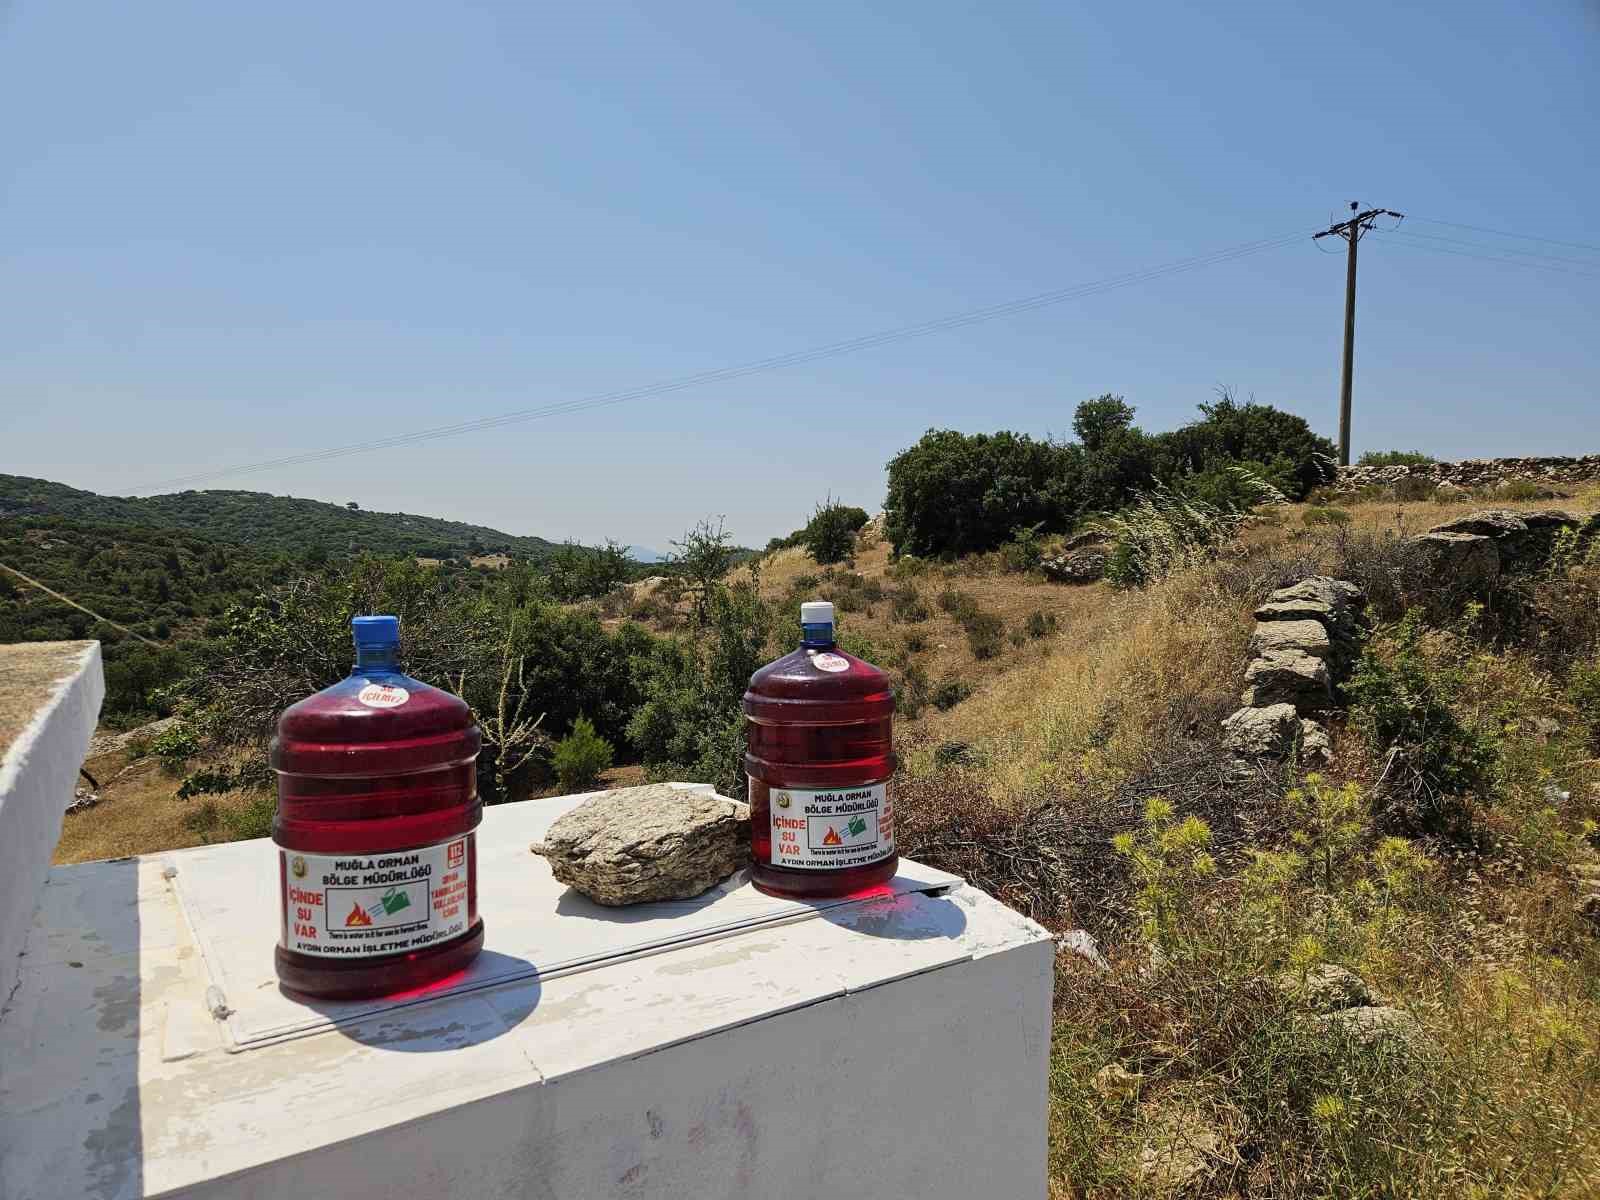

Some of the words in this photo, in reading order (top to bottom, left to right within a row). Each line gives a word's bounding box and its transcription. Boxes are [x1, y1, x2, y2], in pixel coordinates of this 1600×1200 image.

[814, 793, 843, 803] MUĞLA
[845, 791, 872, 801] ORMAN
[805, 804, 832, 814] BÖLGE
[835, 798, 879, 813] MÜDÜRLÜĞÜ
[772, 813, 806, 830] İÇİNDE
[782, 832, 796, 842] SU
[450, 843, 463, 859] 112
[778, 843, 800, 855] VAR
[335, 858, 376, 871] MUĞLA
[378, 854, 419, 868] ORMAN
[781, 858, 804, 866] AYDIN
[806, 858, 834, 866] ORMAN
[836, 856, 866, 866] İŞLETME
[322, 873, 358, 886] BÖLGE
[363, 864, 431, 885] MÜDÜRLÜĞÜ
[289, 884, 323, 906] İÇİNDE
[297, 908, 311, 921] SU
[294, 922, 317, 939] VAR
[297, 942, 321, 953] AYDIN
[323, 943, 360, 953] ORMAN
[363, 940, 409, 954] İŞLETME
